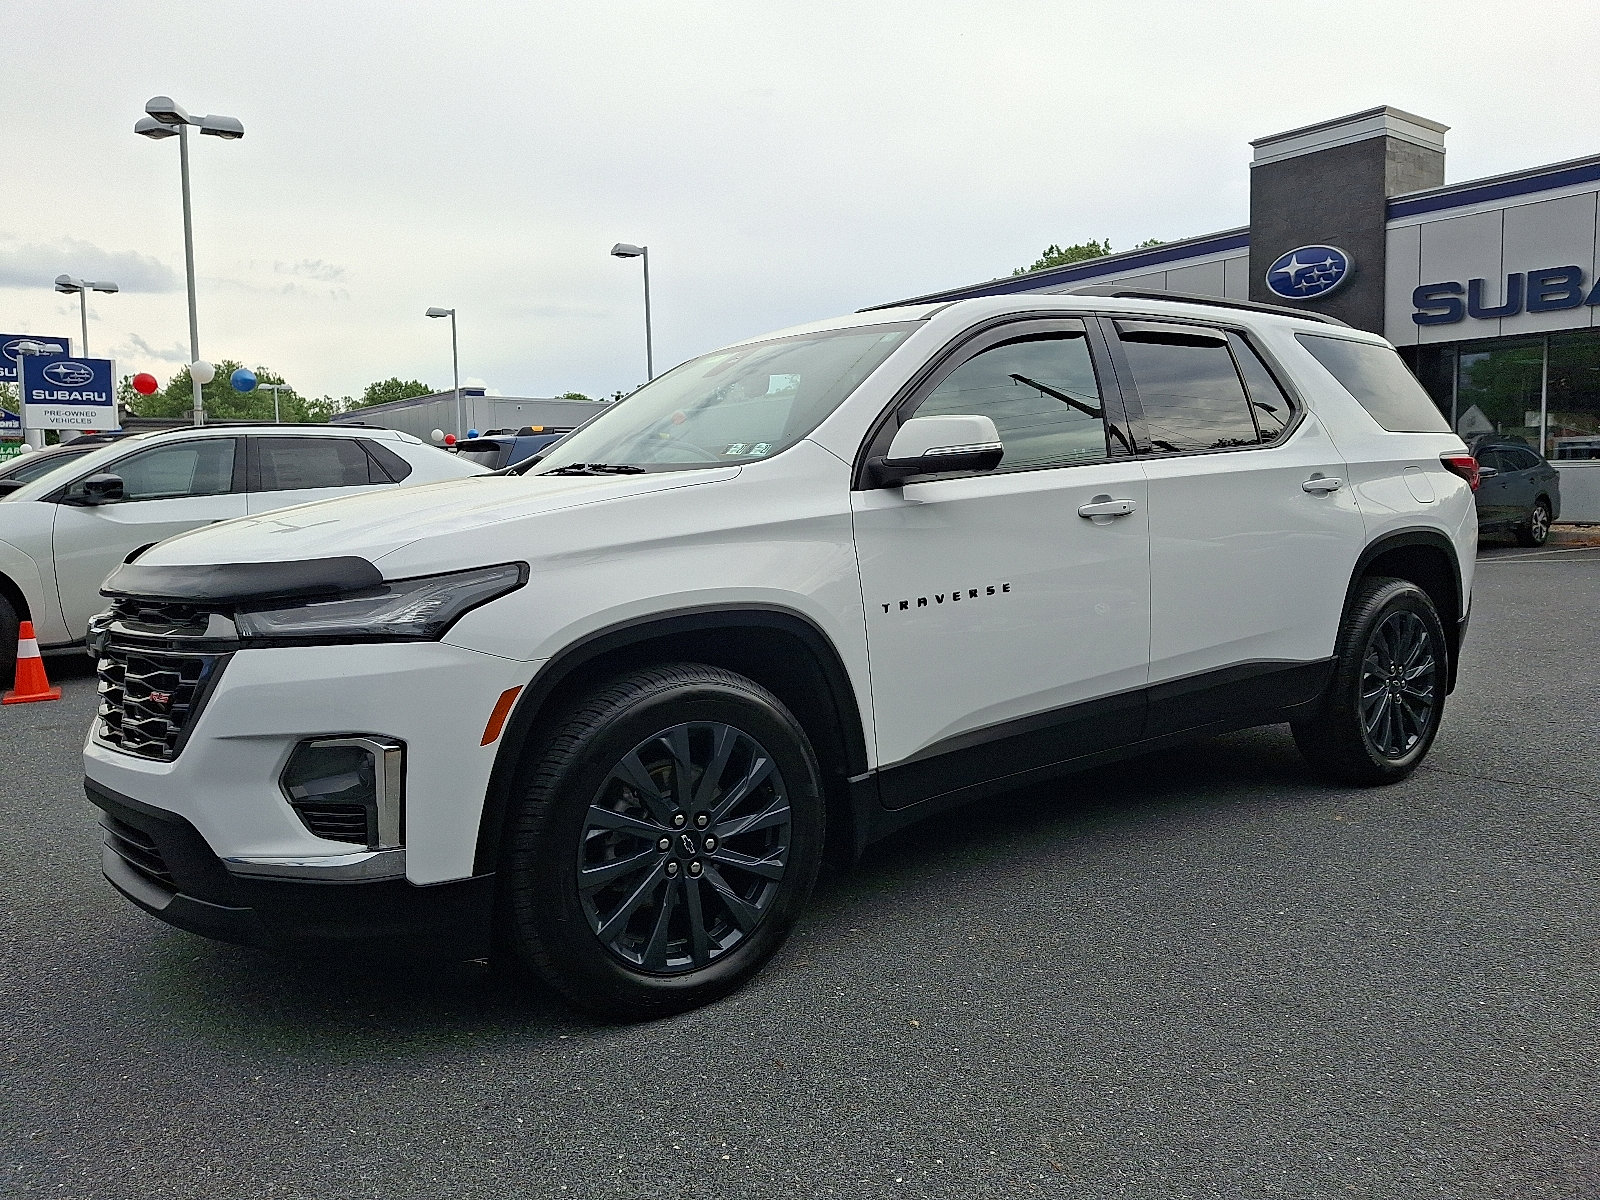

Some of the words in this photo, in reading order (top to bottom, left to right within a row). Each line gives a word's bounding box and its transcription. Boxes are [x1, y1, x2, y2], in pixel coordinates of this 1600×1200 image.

[1412, 265, 1600, 325] SUB
[32, 390, 106, 401] SUBARU
[881, 583, 1011, 614] TRAVERSE
[149, 690, 171, 703] RS
